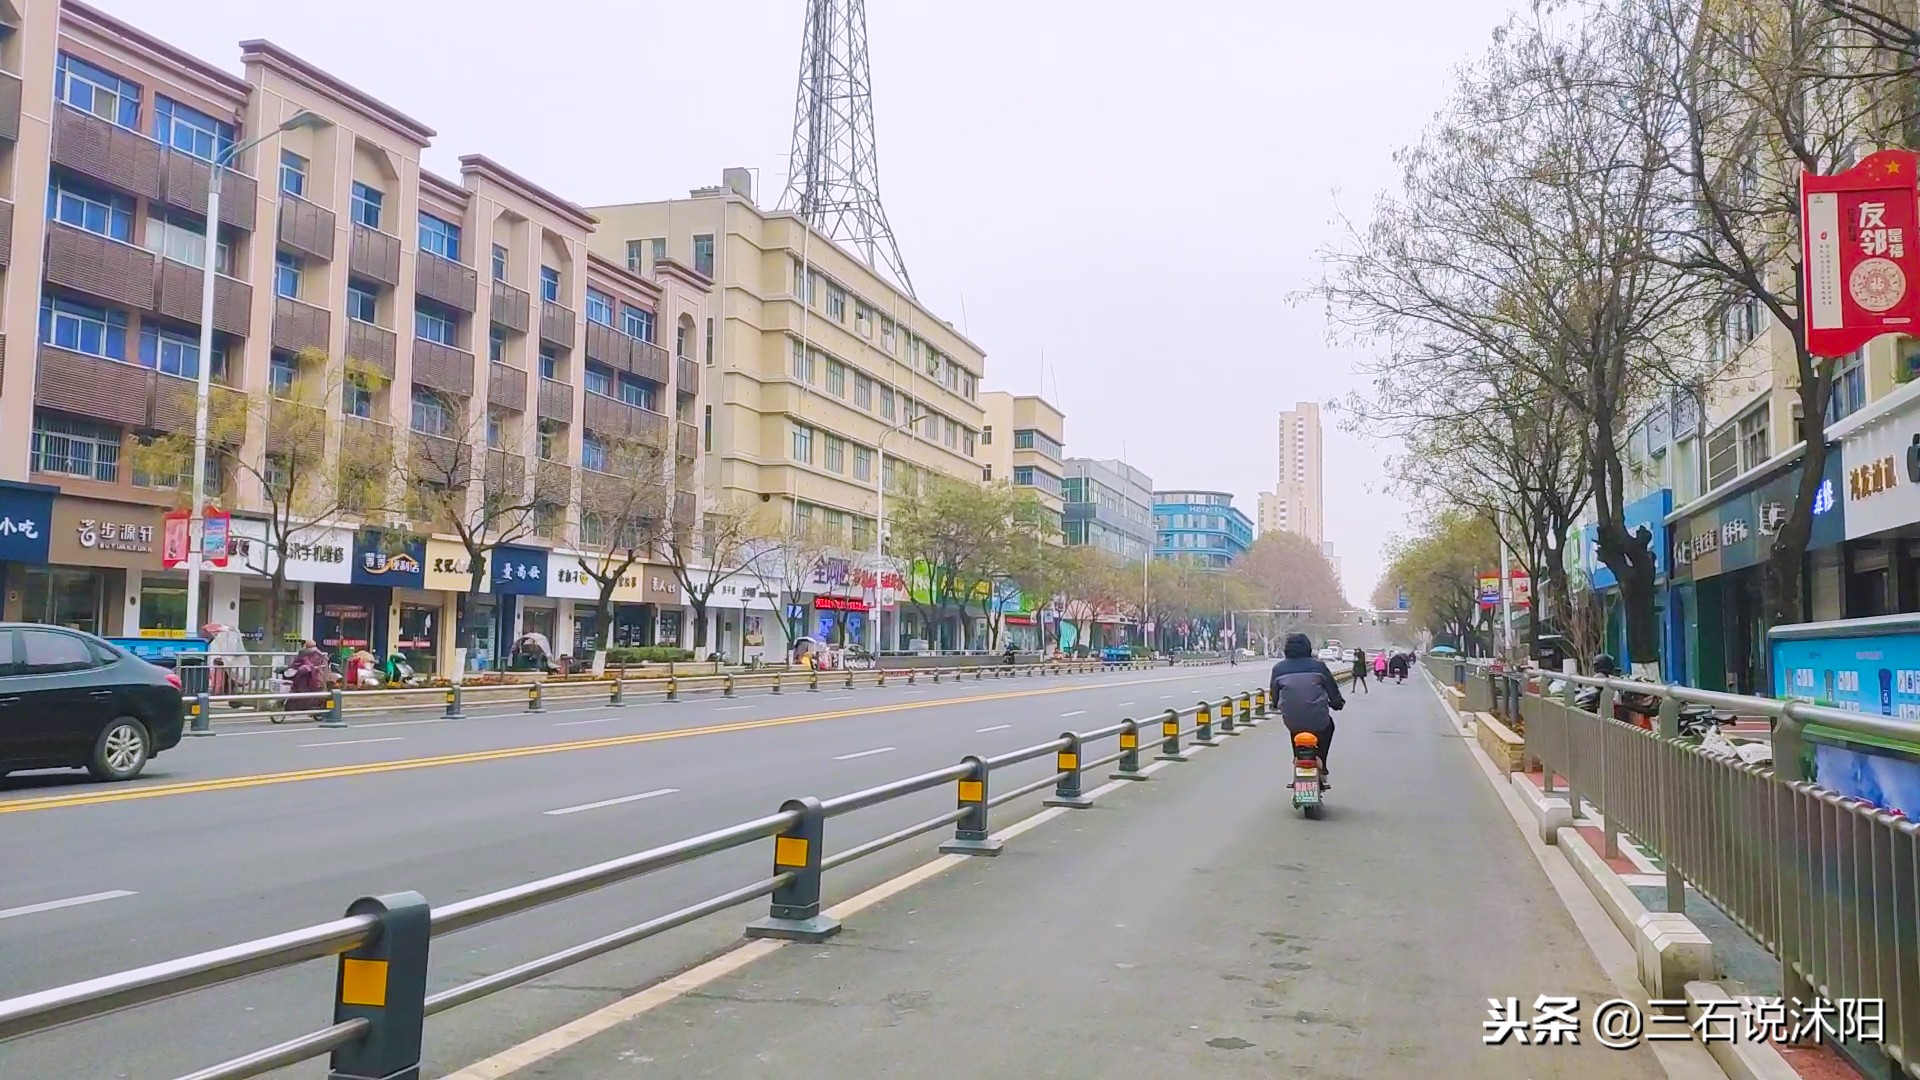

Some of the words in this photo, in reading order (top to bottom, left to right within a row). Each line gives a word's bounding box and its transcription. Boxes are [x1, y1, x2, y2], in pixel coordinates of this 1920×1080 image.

[0, 516, 38, 539] 小吃
[100, 521, 154, 542] 步源轩
